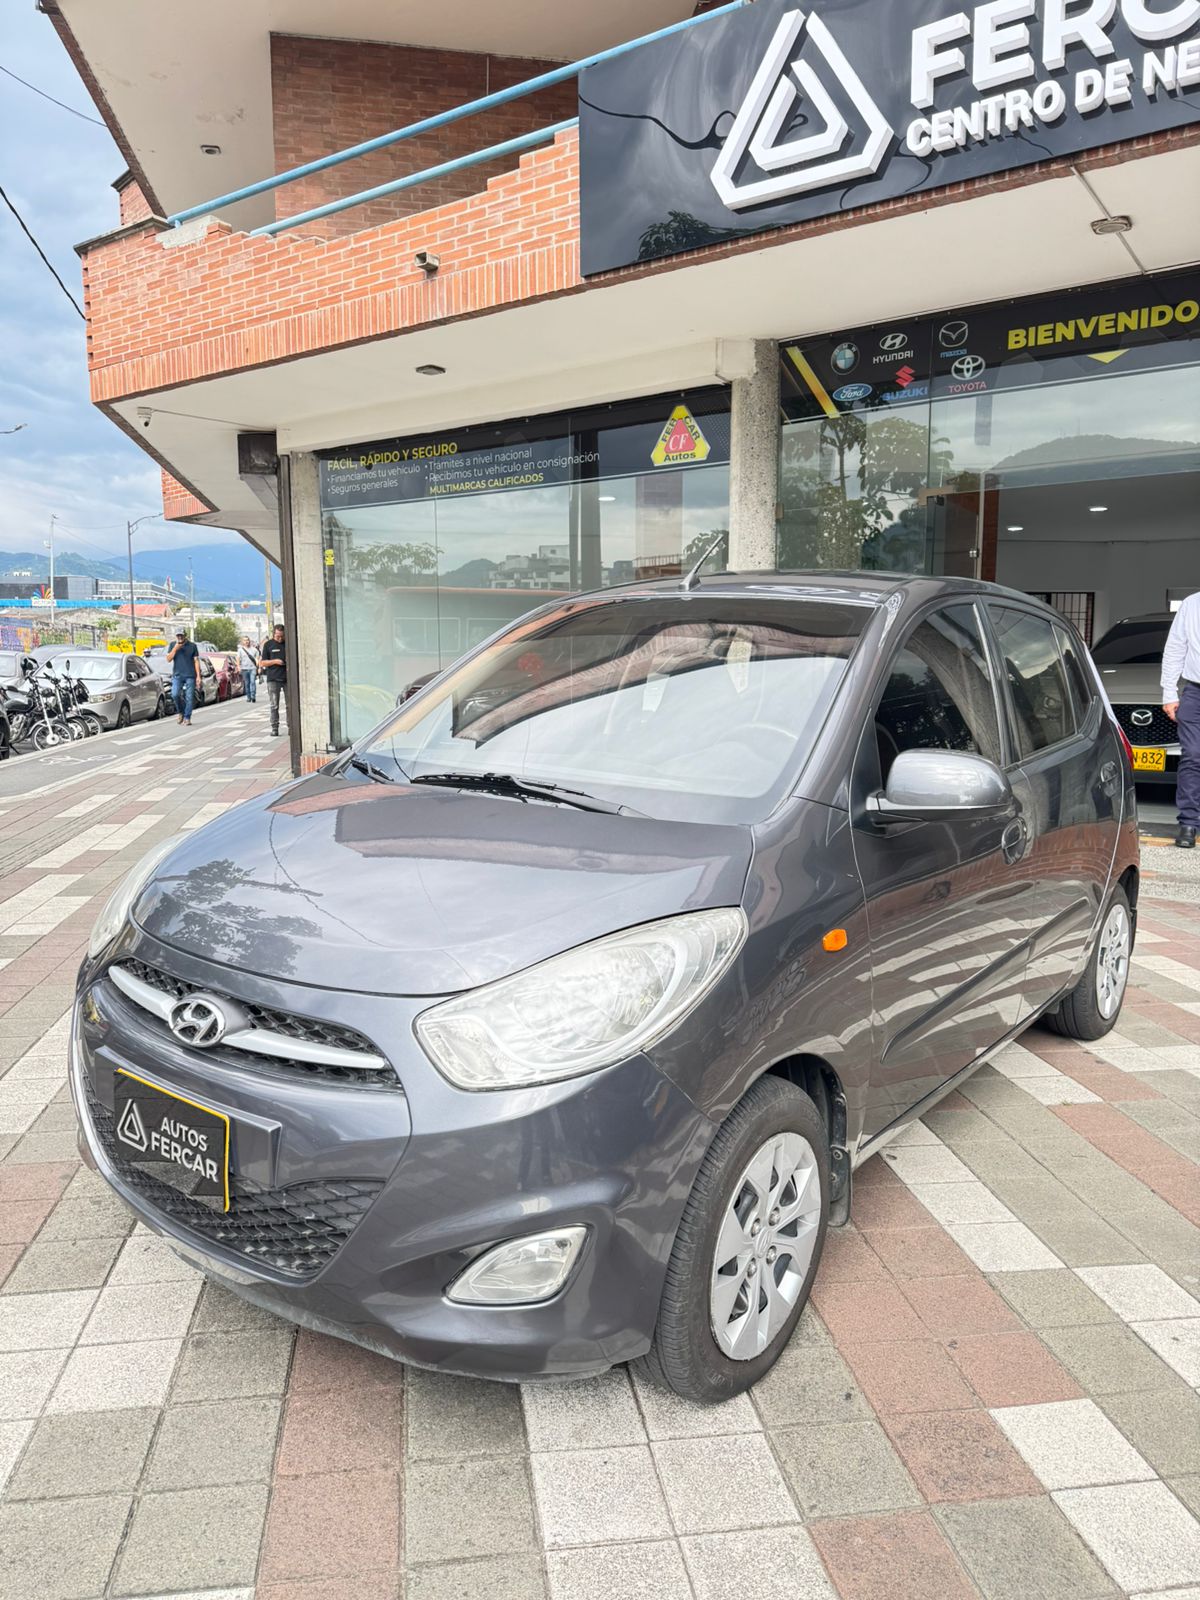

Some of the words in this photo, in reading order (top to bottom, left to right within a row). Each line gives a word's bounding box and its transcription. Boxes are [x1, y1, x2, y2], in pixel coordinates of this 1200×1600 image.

[906, 80, 1067, 157] CENTRO
[1074, 58, 1134, 114] DE
[1007, 299, 1199, 351] BIENVENIDO
[872, 349, 914, 364] HYUNDAI
[940, 348, 968, 358] mazda
[840, 386, 864, 399] Ford
[882, 386, 929, 401] SUZUKI
[949, 381, 987, 394] TOYOTA
[684, 415, 700, 441] CAR
[669, 433, 689, 451] CF
[327, 456, 358, 471] FÁCIL,
[360, 450, 400, 467] RÁPIDO
[402, 449, 410, 461] Y
[412, 442, 458, 460] SEGURO
[465, 457, 471, 466] a
[473, 452, 493, 465] nivel
[494, 447, 533, 463] nacional
[664, 451, 697, 462] Autos
[330, 470, 377, 483] Financiamos
[378, 468, 387, 478] tu
[387, 463, 421, 476] vehículo
[429, 467, 472, 482] Recibimos
[473, 465, 483, 476] tu
[484, 460, 522, 476] vehículo
[523, 461, 536, 470] en
[536, 451, 601, 470] consignación
[330, 483, 361, 495] Seguros
[361, 478, 399, 493] generales
[429, 479, 486, 495] MULTIMARCAS
[488, 473, 544, 488] CALIFICADOS
[1141, 751, 1163, 764] 832
[160, 1116, 209, 1152] AUTOS
[151, 1130, 219, 1183] FERCAR
